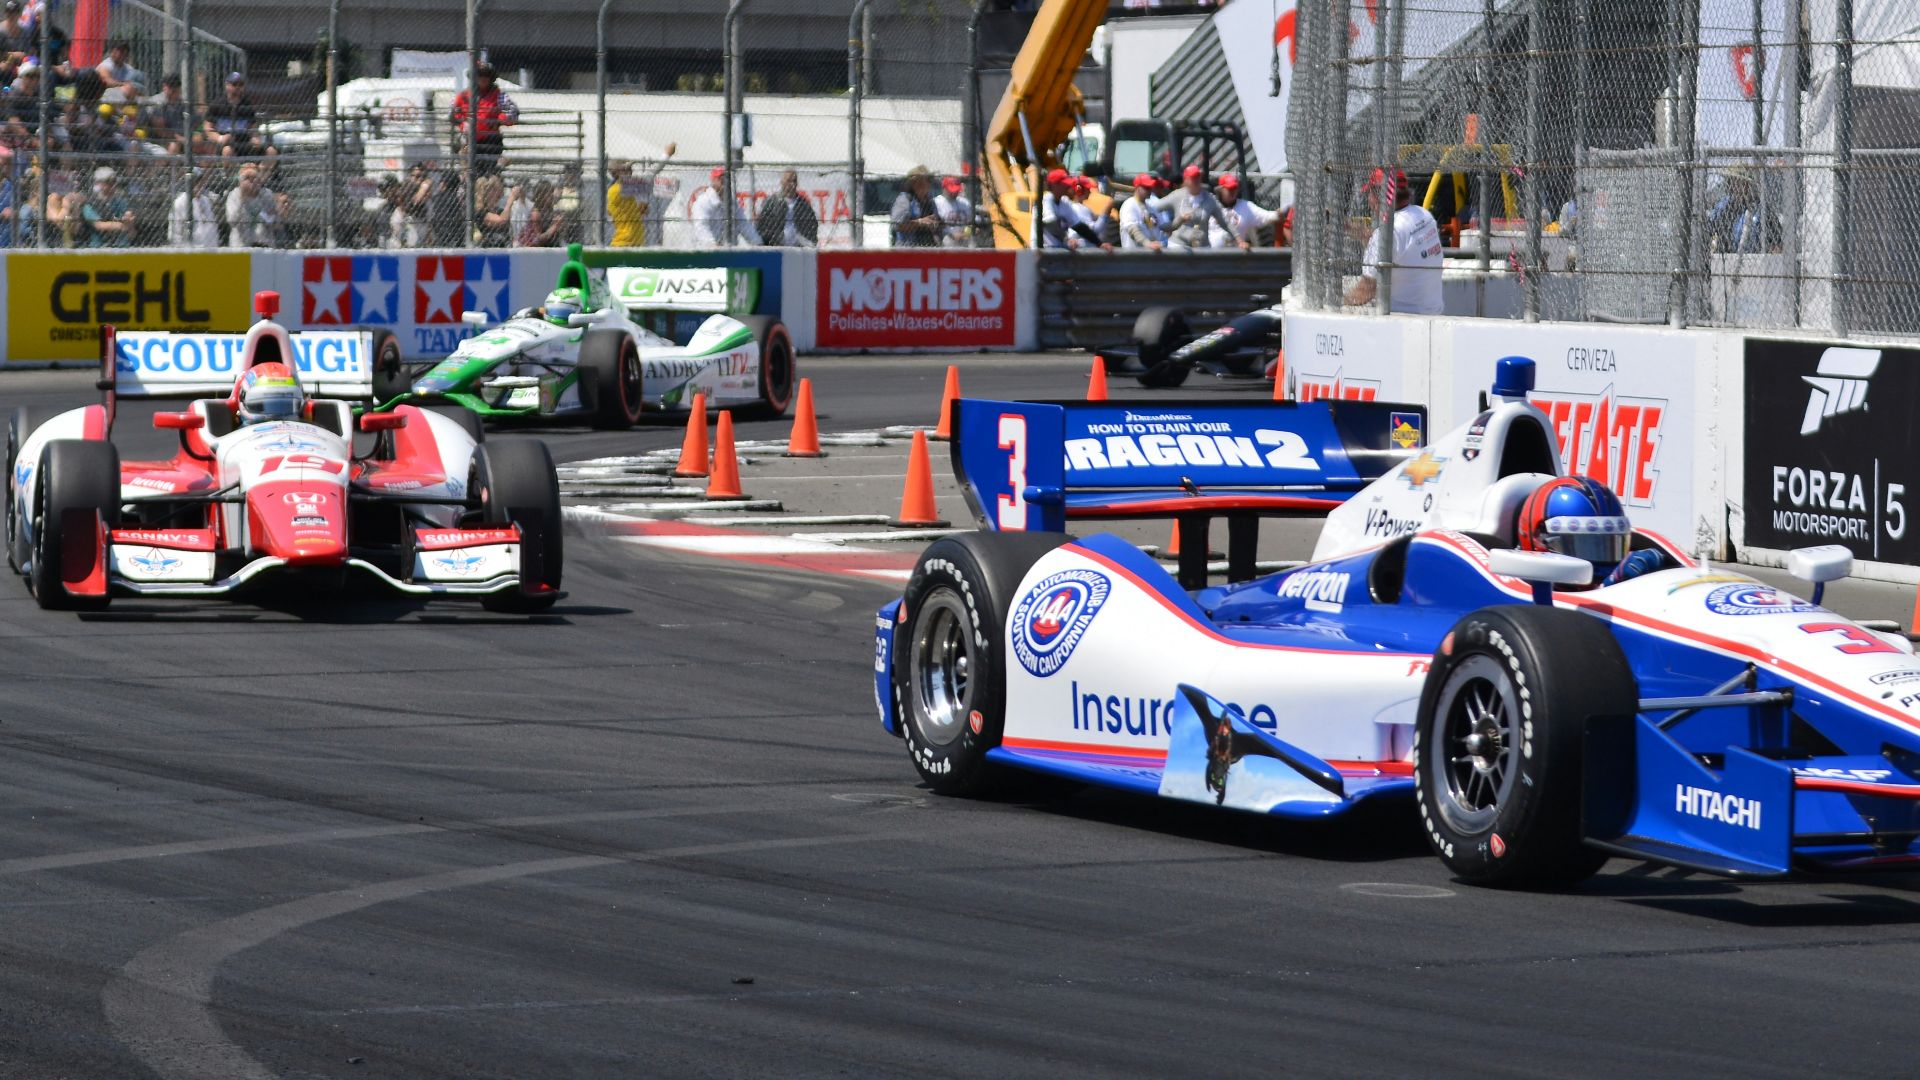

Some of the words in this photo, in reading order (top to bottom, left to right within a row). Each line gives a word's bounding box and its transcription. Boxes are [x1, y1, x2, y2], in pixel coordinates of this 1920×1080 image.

[50, 270, 211, 323] GEHL
[830, 267, 1003, 311] MOTHERS
[116, 337, 358, 372] SCOUNG!
[1316, 333, 1344, 356] CERVEZA
[1566, 347, 1617, 371] CERVEZA
[1064, 434, 1265, 471] RAGON
[1255, 428, 1321, 471] 2
[1088, 424, 1124, 434] HOW
[1126, 423, 1146, 433] TO
[1149, 423, 1189, 433] TRAIN
[1193, 422, 1231, 432] YOUR
[998, 413, 1027, 531] 3
[1773, 465, 1867, 513] FORZA
[1364, 508, 1423, 537] V-Power
[1885, 483, 1906, 540] 5
[118, 531, 201, 544] SONNY'S
[1032, 595, 1076, 625] AAA
[1277, 564, 1350, 614] verizon
[1012, 603, 1039, 672] SOUTHERN
[1038, 614, 1093, 674] CALIFORNIA
[1797, 622, 1906, 654] 3
[1676, 783, 1761, 831] HITACHI
